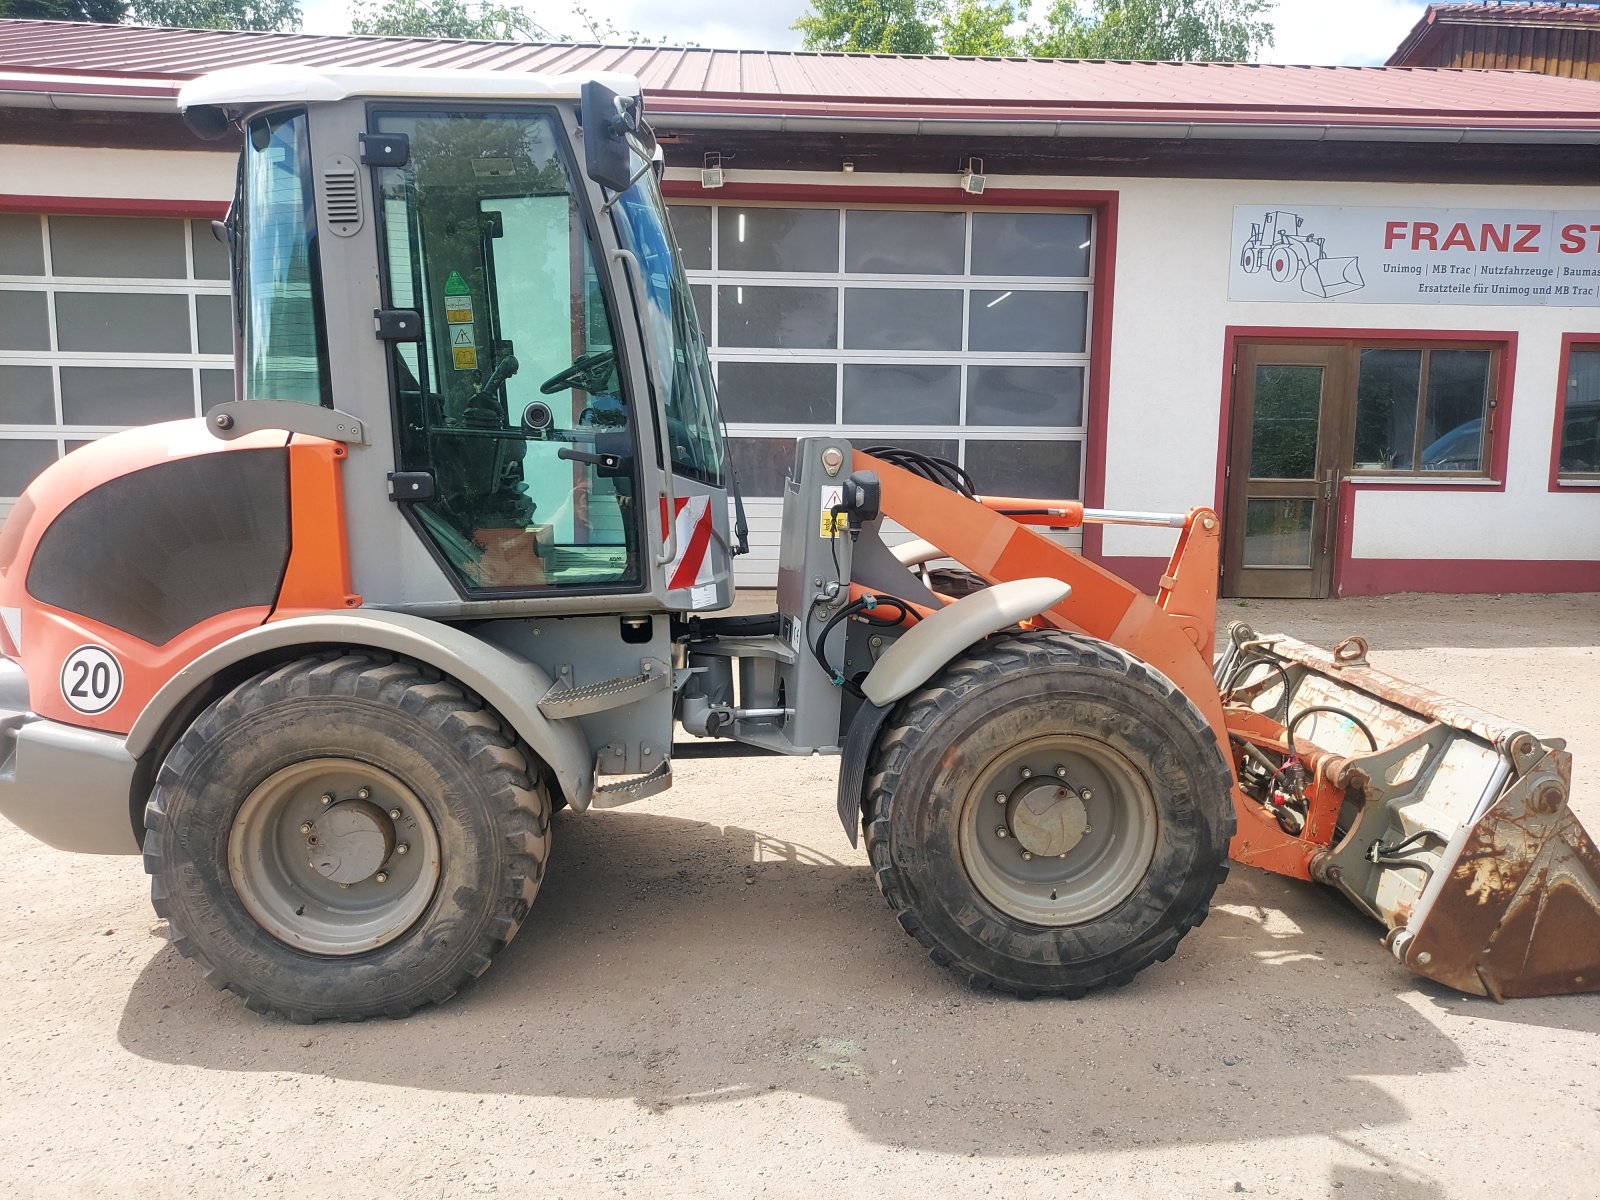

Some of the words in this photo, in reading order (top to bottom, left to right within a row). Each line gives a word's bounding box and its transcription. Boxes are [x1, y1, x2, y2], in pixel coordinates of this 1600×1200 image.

[1383, 221, 1542, 252] FRANZ
[1383, 263, 1422, 275] Unimog
[1432, 264, 1447, 274] MB
[1449, 264, 1471, 274] Trac
[1480, 265, 1554, 278] Nutzfahrzeuge
[1418, 283, 1471, 293] Ersatzteile
[1473, 283, 1489, 294] für
[1491, 284, 1530, 296] Unimog
[1532, 285, 1552, 295] und
[1554, 286, 1569, 295] MB
[1572, 286, 1593, 295] Trac
[70, 660, 111, 699] 20
